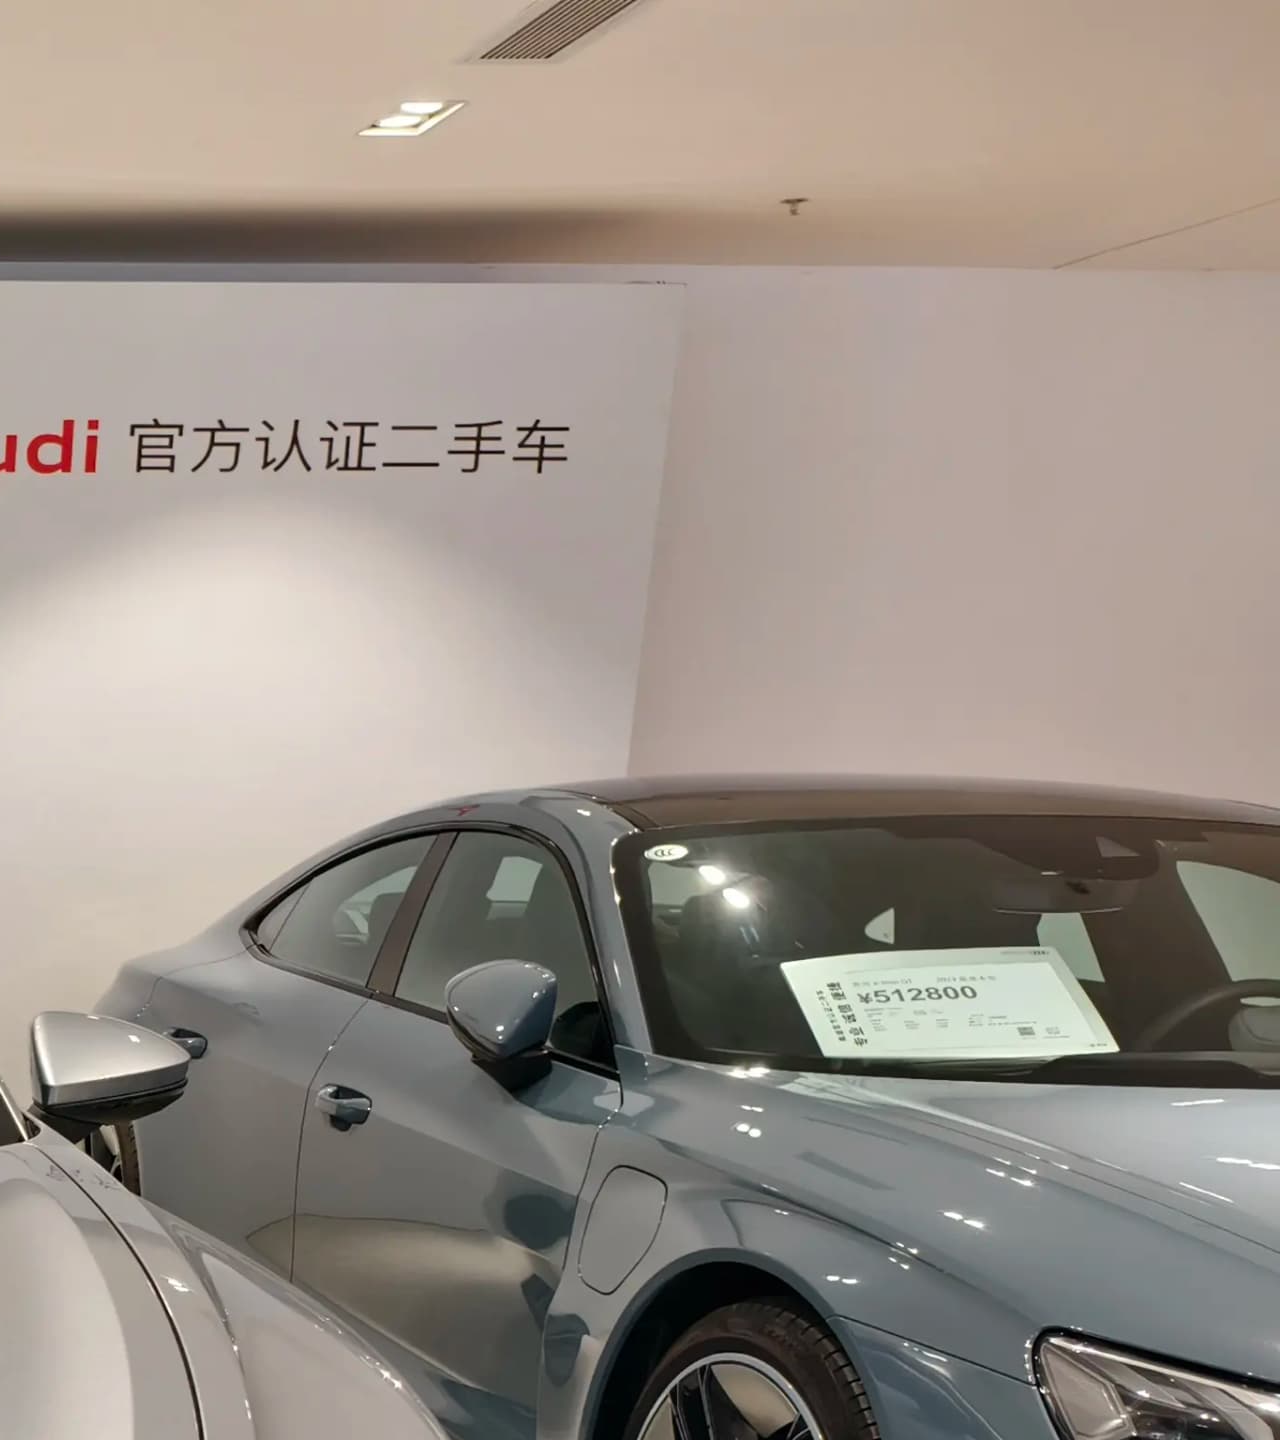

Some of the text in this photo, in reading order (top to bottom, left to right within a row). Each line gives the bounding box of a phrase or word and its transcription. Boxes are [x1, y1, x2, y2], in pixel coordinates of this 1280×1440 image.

[129, 419, 571, 474] 官方认证二手车
[857, 985, 978, 1004] ¥512800
